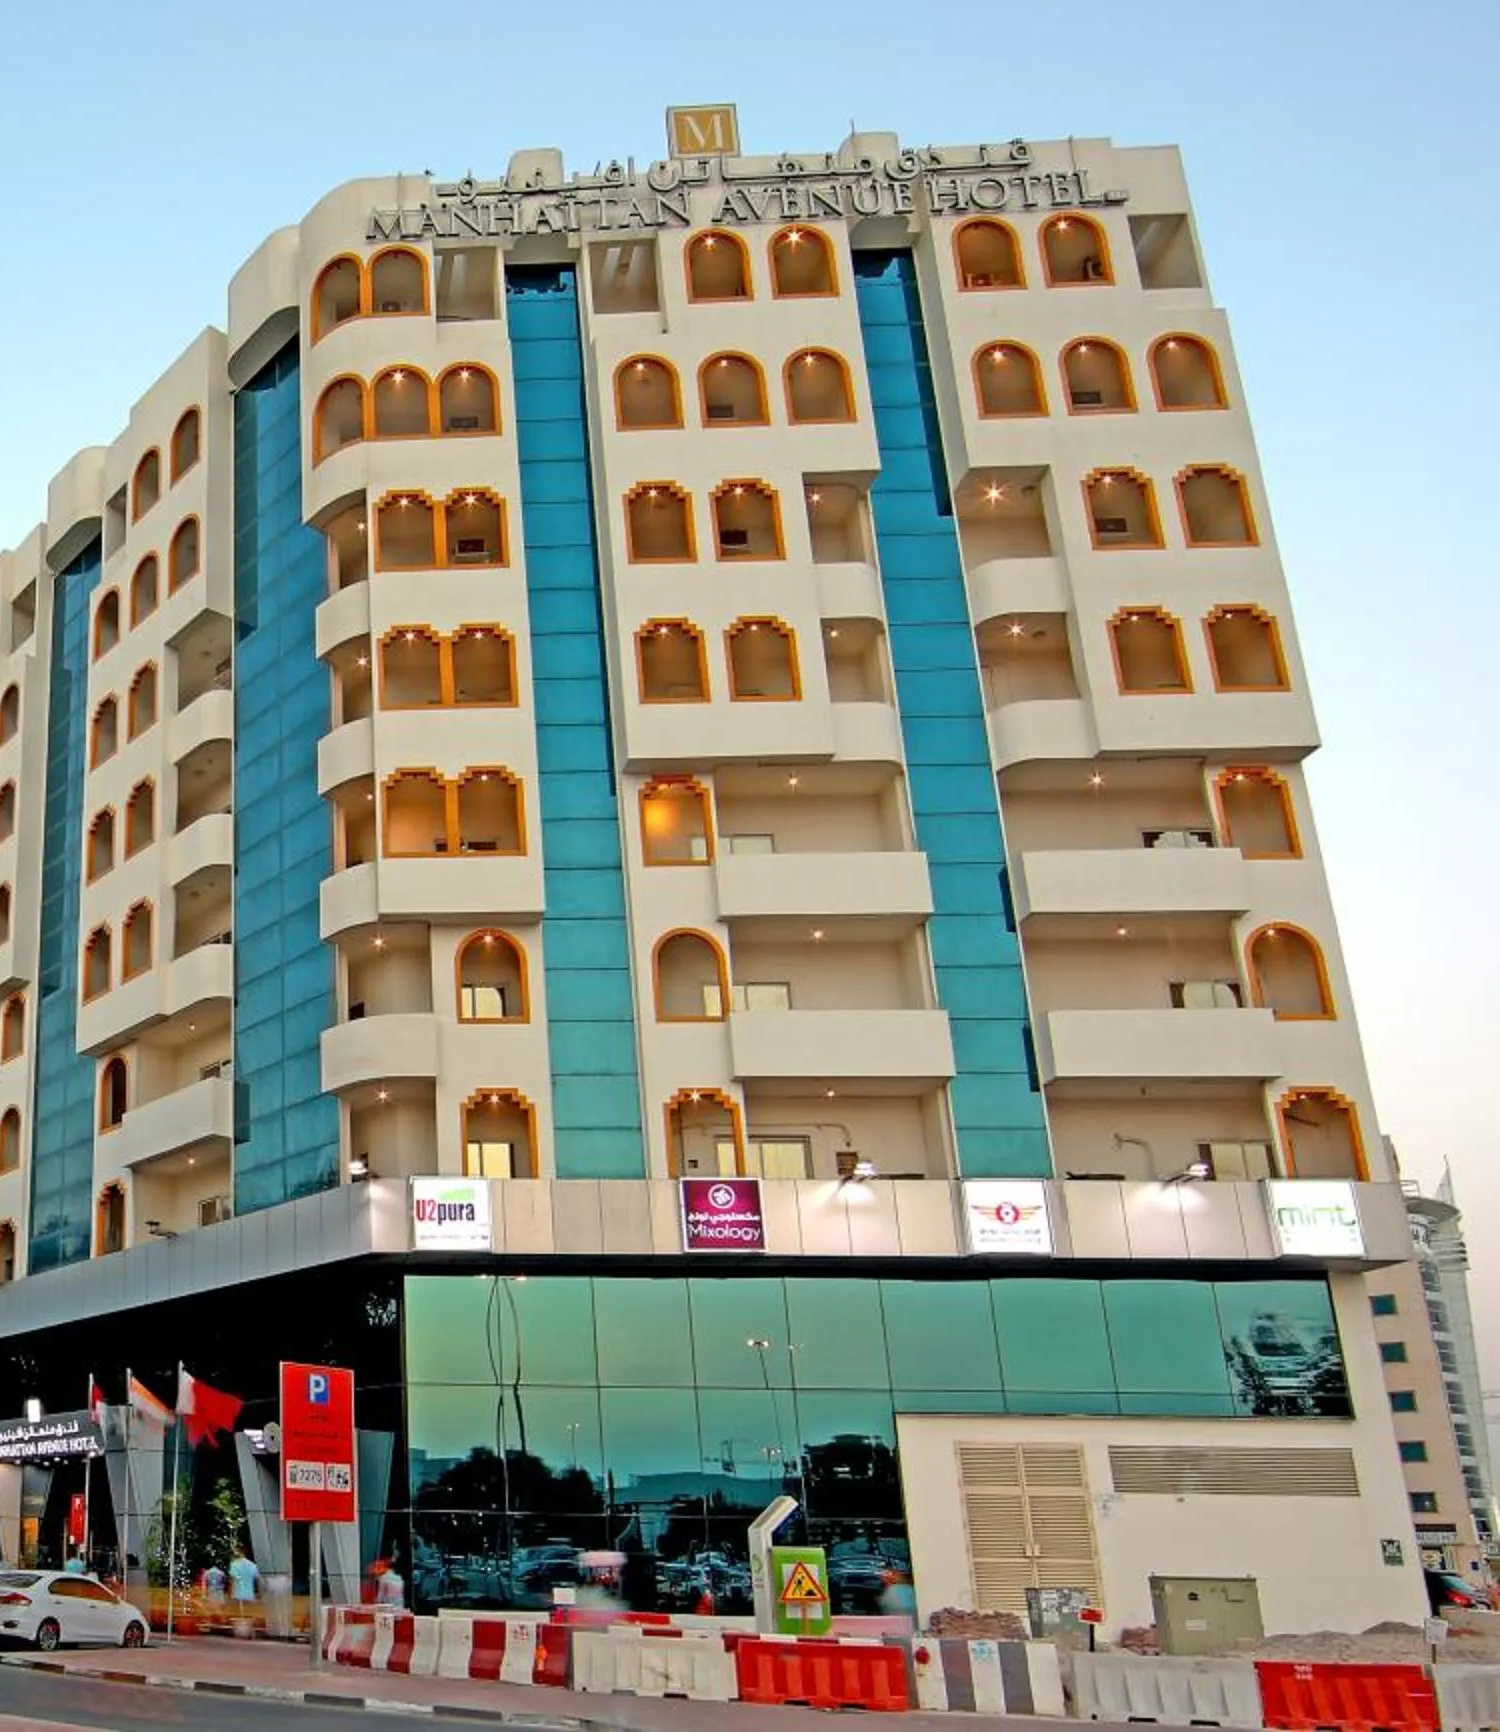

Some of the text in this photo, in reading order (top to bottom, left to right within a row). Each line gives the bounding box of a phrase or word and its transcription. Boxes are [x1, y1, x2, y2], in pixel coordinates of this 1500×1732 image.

[684, 113, 725, 150] M
[366, 168, 1105, 238] MANHATTAN AVENUE HOTEL
[415, 1199, 475, 1226] U2pura
[1277, 1204, 1357, 1227] mint
[688, 1223, 761, 1241] Mixology
[309, 1374, 326, 1404] P
[38, 1437, 68, 1456] AVENUE
